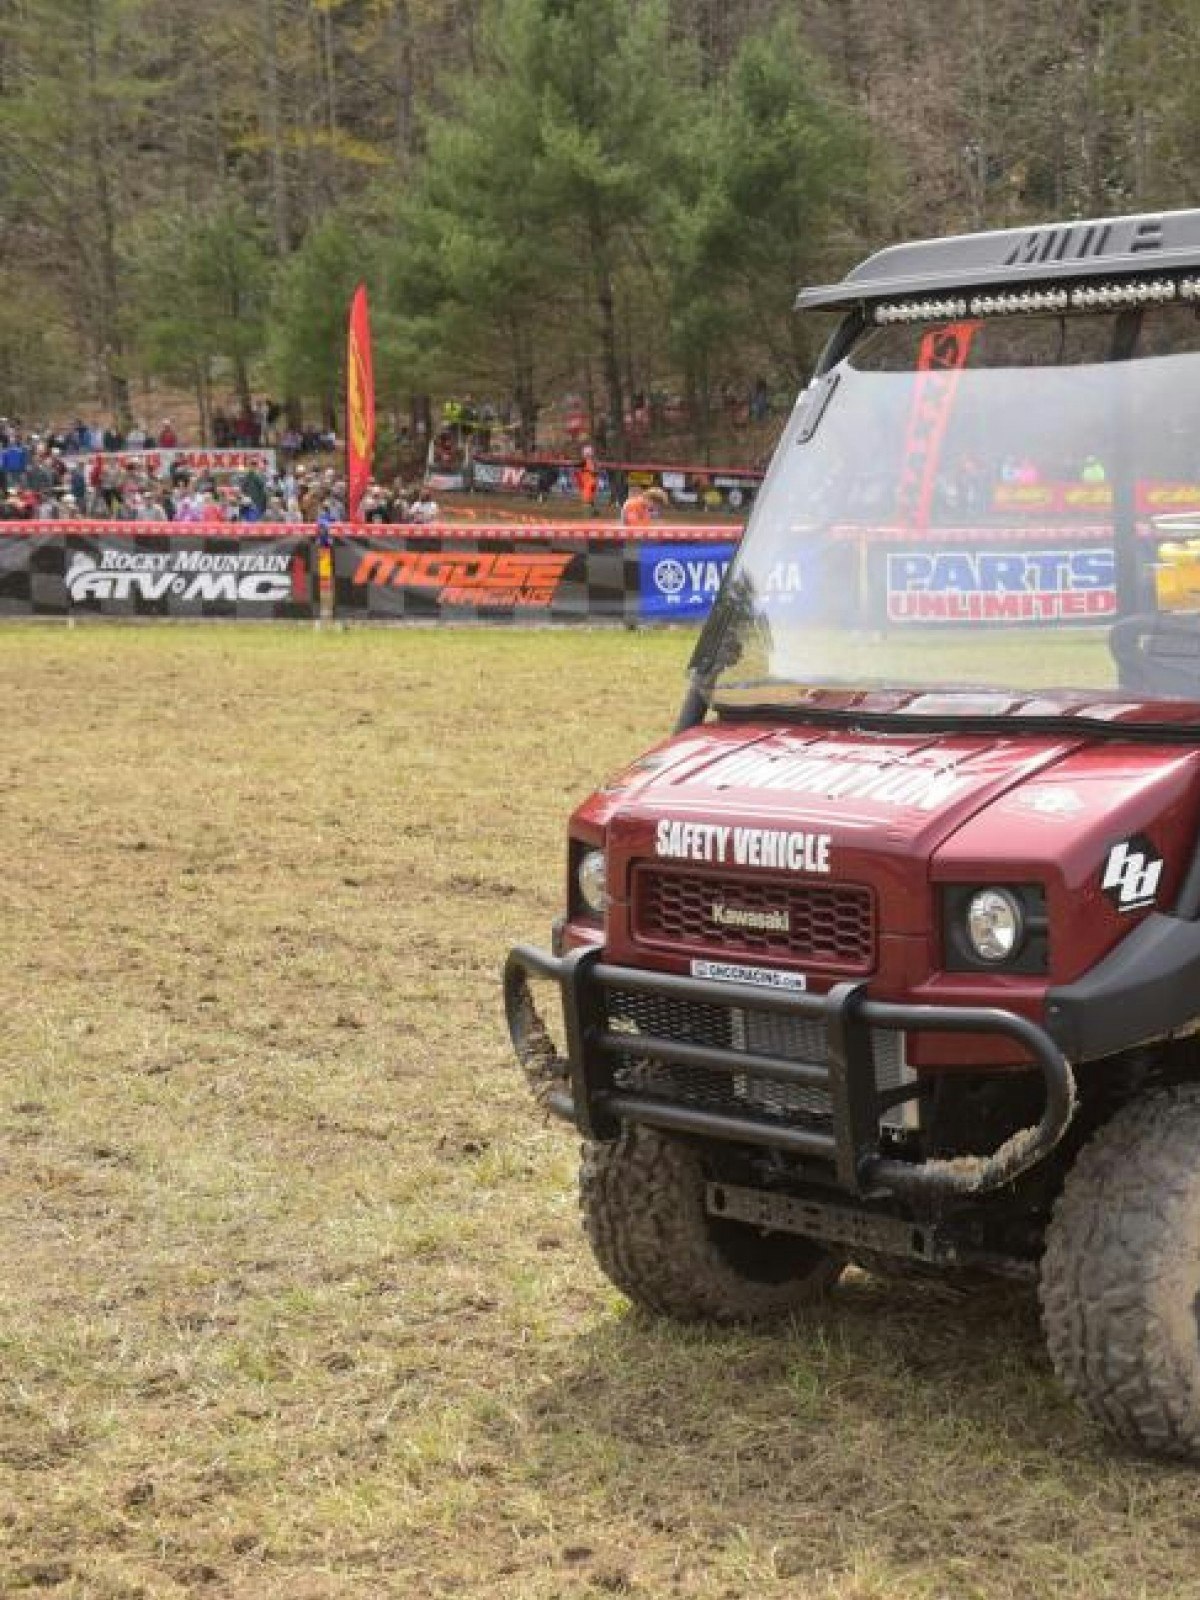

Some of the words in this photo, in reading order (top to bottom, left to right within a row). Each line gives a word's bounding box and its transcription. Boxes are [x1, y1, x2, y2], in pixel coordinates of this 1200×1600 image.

[100, 550, 172, 571] ROCKY
[175, 551, 291, 571] MOUNTAIN
[886, 550, 1114, 589] PARTS
[888, 589, 1117, 618] UNLIMITED
[655, 819, 732, 863] SAFETY
[733, 826, 832, 873] VEHICLE
[711, 903, 790, 932] Kawasaki
